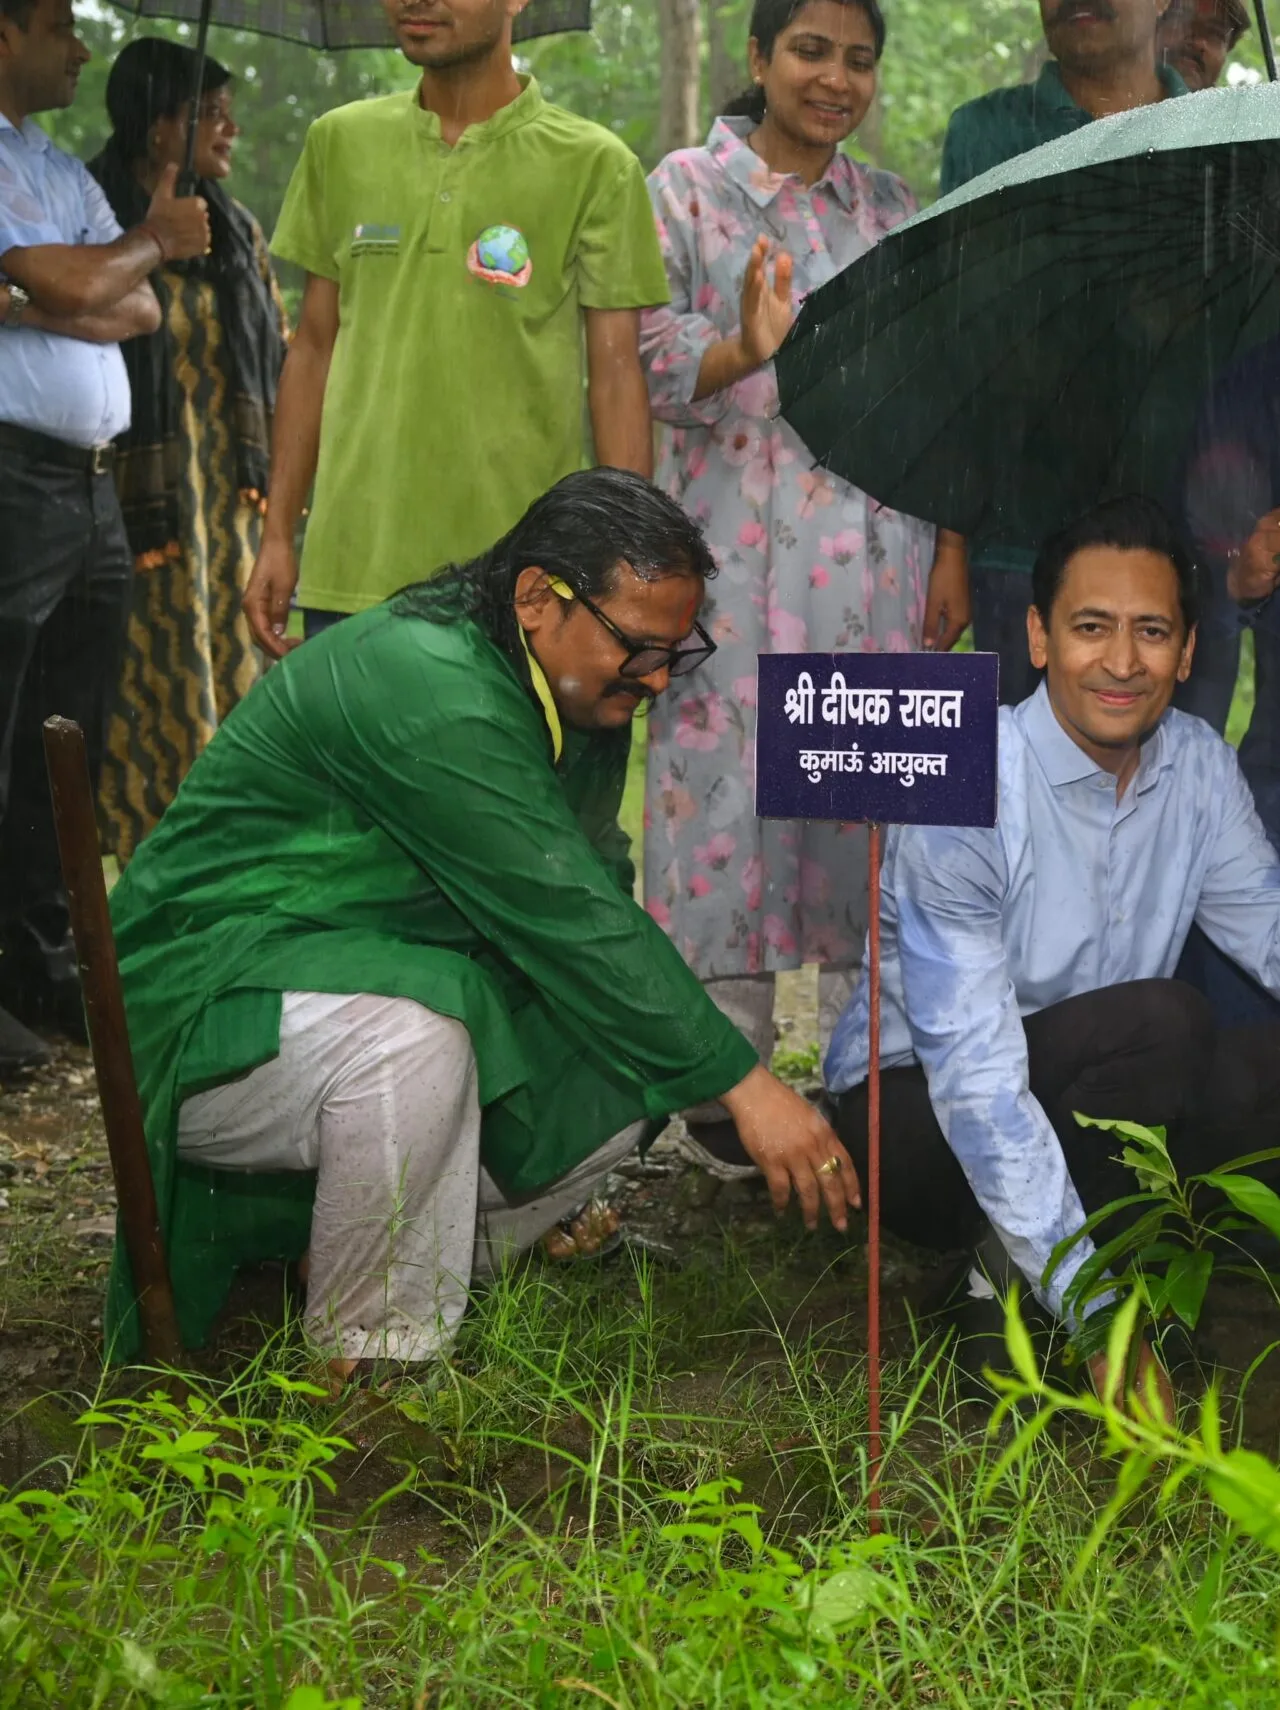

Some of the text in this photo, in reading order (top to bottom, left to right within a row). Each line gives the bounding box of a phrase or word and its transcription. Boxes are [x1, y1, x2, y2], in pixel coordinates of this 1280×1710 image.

[783, 671, 964, 728] श्री दीपक रावत
[799, 742, 948, 787] कुमाऊं आयुक्त
